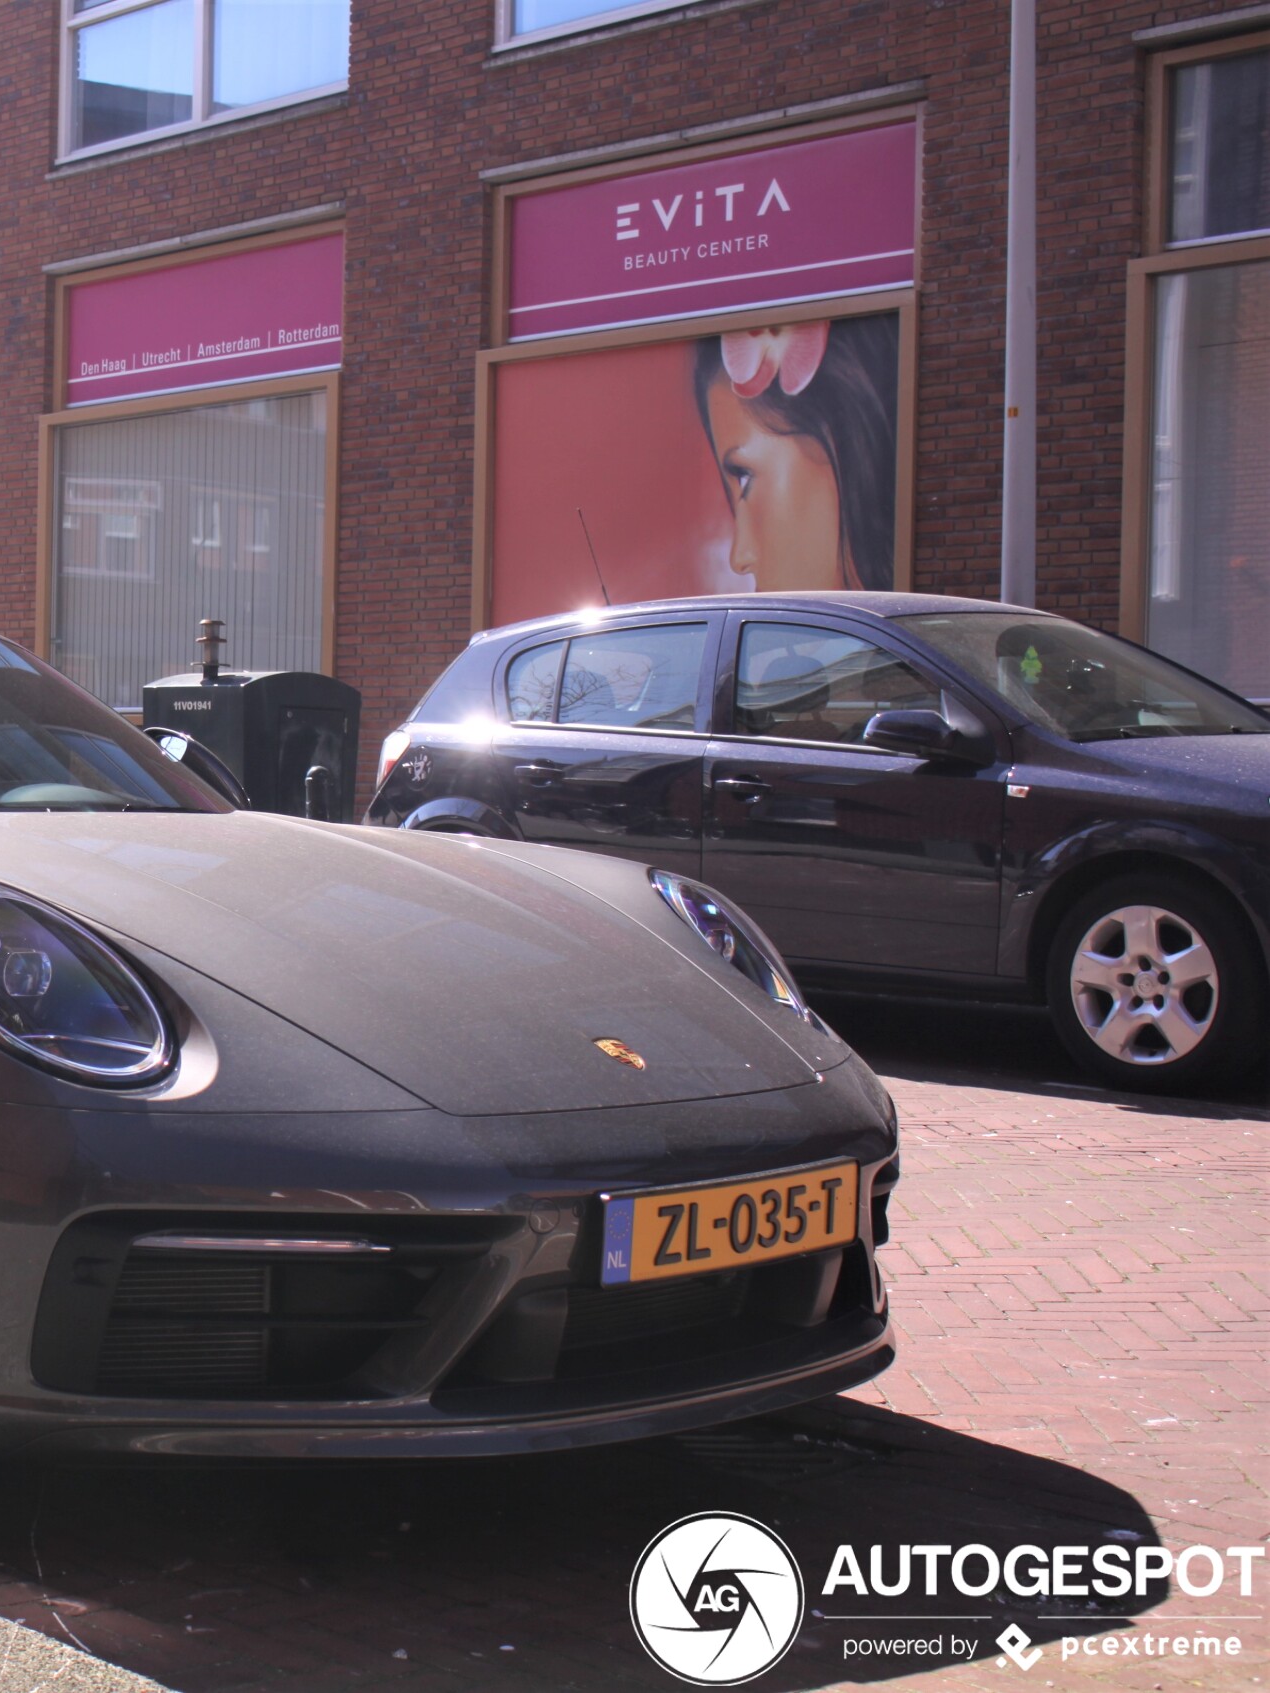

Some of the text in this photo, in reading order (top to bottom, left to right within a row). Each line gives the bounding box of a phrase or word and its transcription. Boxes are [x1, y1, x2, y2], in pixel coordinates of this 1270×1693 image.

[623, 233, 769, 271] BEAUTY CENTER
[81, 323, 340, 376] Den Haag Utrecht Amsterdam Rotterdam
[654, 1177, 843, 1266] ZL-035-T
[606, 1249, 627, 1270] NL
